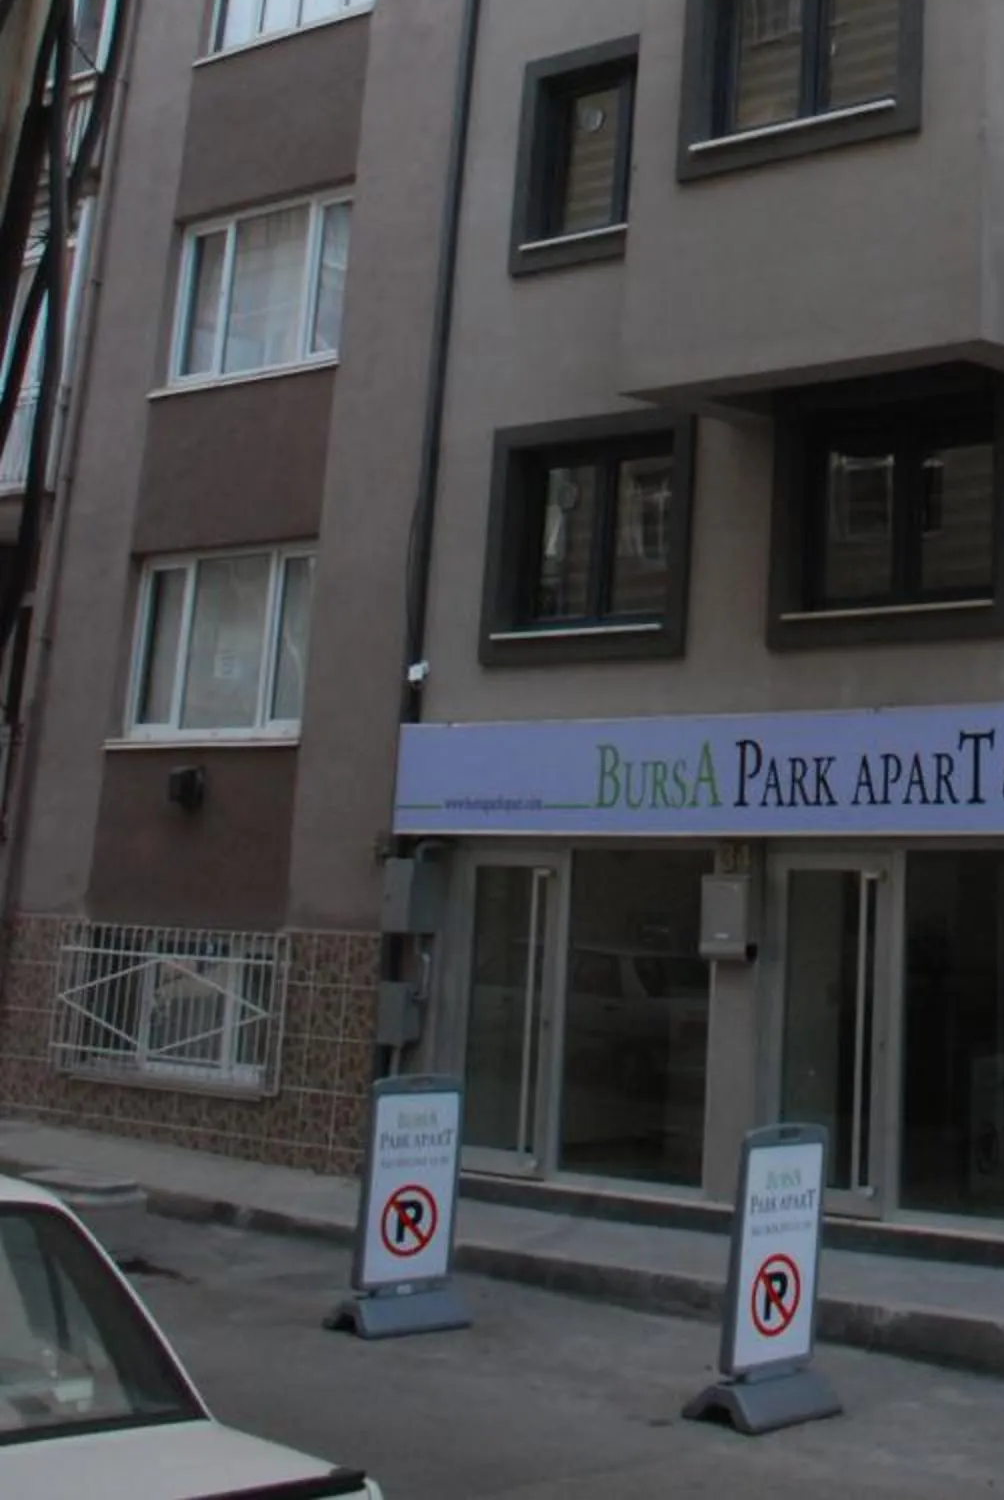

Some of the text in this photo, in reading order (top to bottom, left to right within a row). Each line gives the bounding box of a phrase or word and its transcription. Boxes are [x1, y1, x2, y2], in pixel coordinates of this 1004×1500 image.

[597, 741, 722, 810] BURSA
[734, 739, 838, 807] PARK
[851, 730, 995, 806] APART
